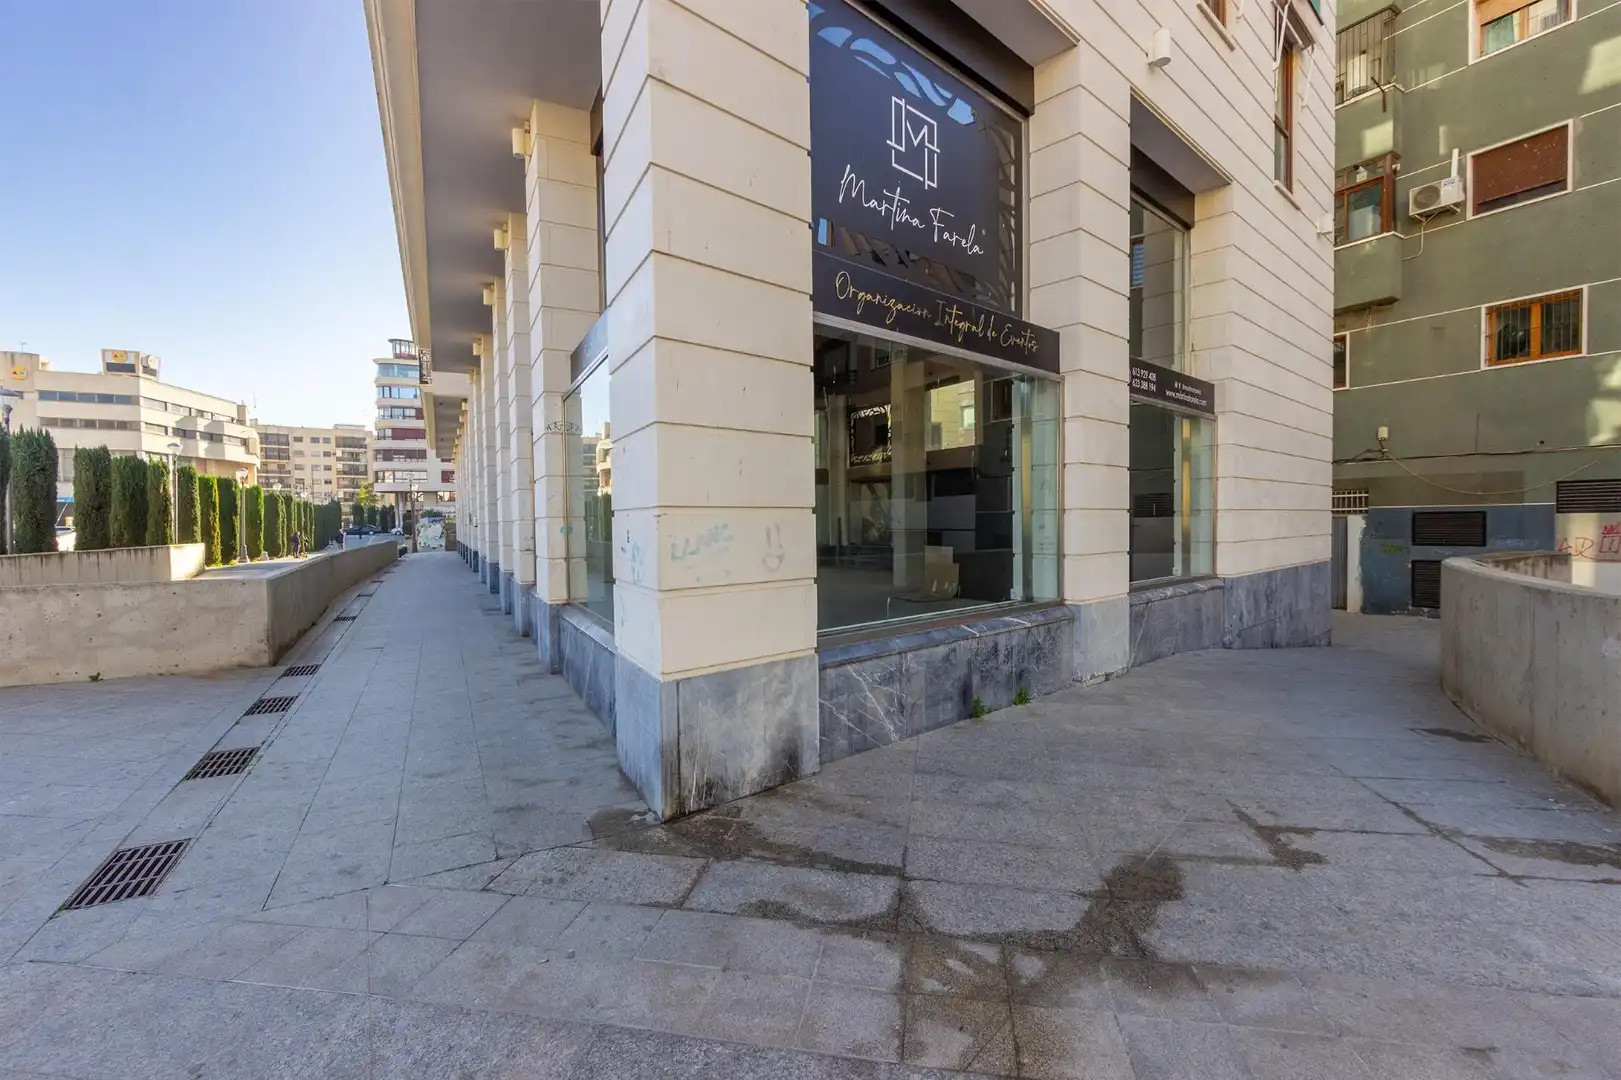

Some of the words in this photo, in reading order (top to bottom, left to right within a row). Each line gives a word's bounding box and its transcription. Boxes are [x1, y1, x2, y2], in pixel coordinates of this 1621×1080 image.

[838, 164, 925, 231] Martina
[929, 207, 984, 256] Farela
[934, 300, 985, 343] Integral
[987, 314, 998, 342] de
[1000, 323, 1039, 355] Eventos
